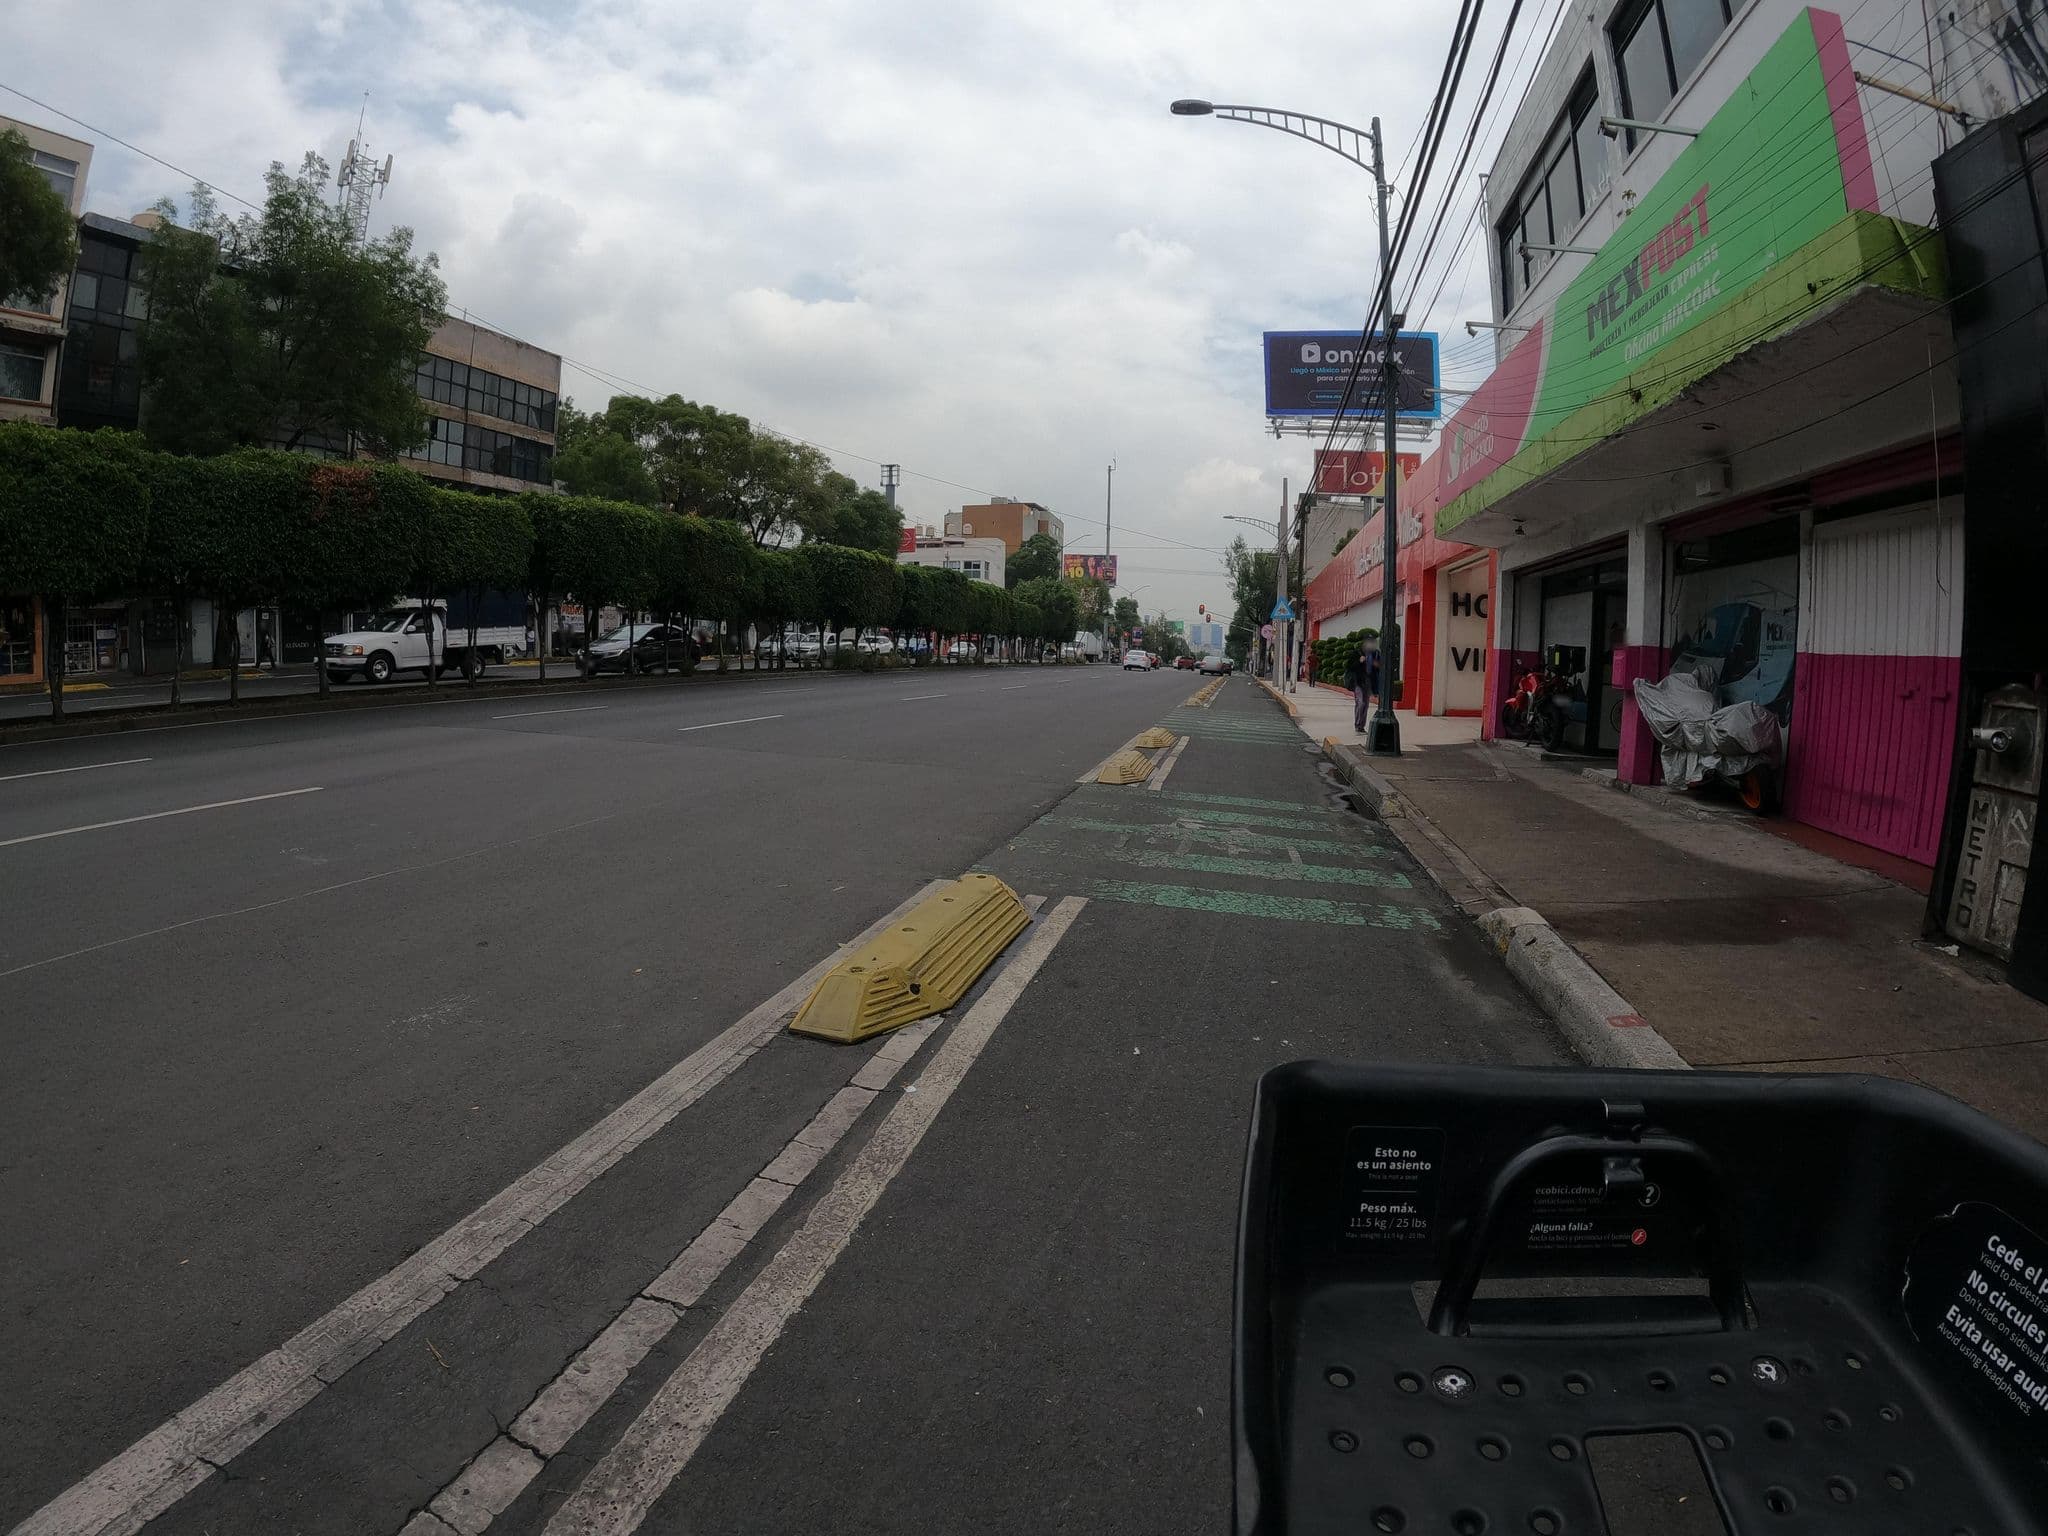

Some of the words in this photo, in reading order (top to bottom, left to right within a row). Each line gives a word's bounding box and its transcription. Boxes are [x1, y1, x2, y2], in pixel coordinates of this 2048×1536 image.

[1587, 182, 1711, 342] MEXPOST
[1356, 1161, 1370, 1170] es
[1371, 1161, 1387, 1170] un
[1389, 1160, 1432, 1171] asiento
[1375, 1147, 1400, 1158] Esto
[1402, 1150, 1417, 1158] no
[1350, 1217, 1373, 1228] 11.5
[1374, 1217, 1388, 1230] kg
[1396, 1218, 1409, 1229] 25
[1411, 1217, 1428, 1229] lbs
[1360, 1202, 1387, 1214] Peso
[1389, 1202, 1418, 1214] máx.
[1529, 1222, 1567, 1235] ¿Alguna
[1568, 1221, 1594, 1232] falla?
[1979, 1251, 2001, 1274] Yield
[1999, 1268, 2011, 1282] to
[1986, 1235, 2025, 1272] Cede
[2024, 1267, 2043, 1286] el
[1958, 1286, 1984, 1311] Don't
[1980, 1302, 1999, 1327] ride
[1996, 1321, 2010, 1336] on
[1967, 1269, 1989, 1295] No
[1988, 1291, 2047, 1345] circules
[1945, 1304, 1984, 1345] Evita
[1981, 1337, 2017, 1373] usar
[1937, 1321, 1961, 1348] Avoid
[1958, 1341, 1981, 1370] using
[1979, 1359, 2032, 1417] headphones.
